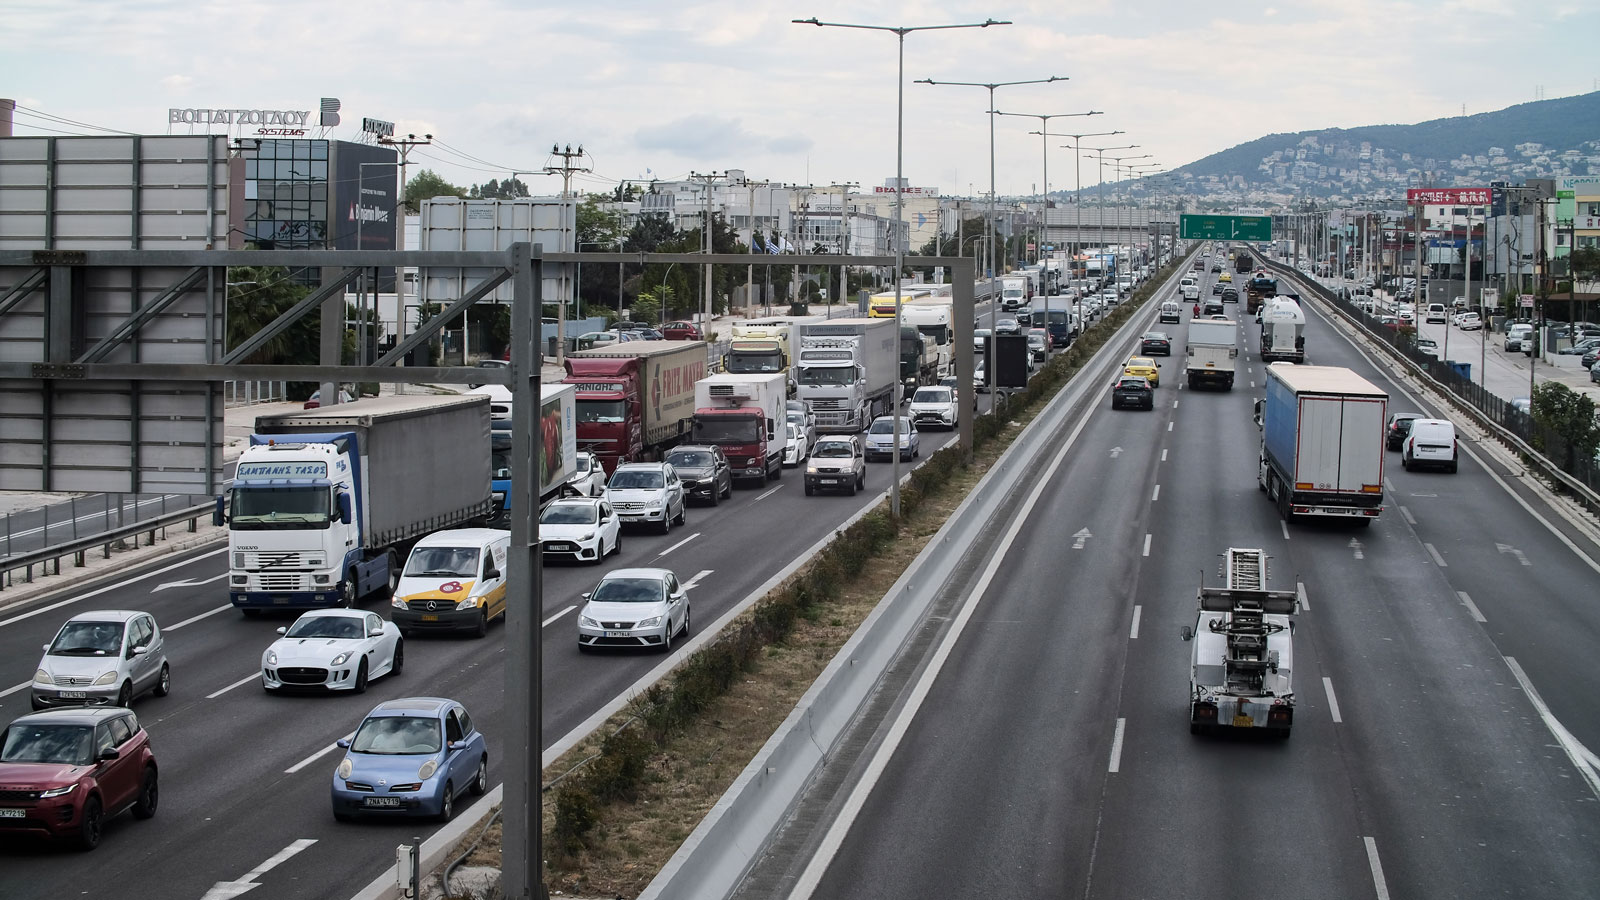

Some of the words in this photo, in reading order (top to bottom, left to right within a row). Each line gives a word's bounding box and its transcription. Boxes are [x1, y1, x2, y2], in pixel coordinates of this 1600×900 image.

[169, 108, 311, 125] ΒΟΓΙΑΤΖΟΓΛΟΥ
[257, 128, 306, 136] SYSTEMS
[355, 203, 375, 225] Bnjamin
[662, 367, 681, 399] FRITZ
[295, 465, 327, 475] ΤΑΣΟΣ
